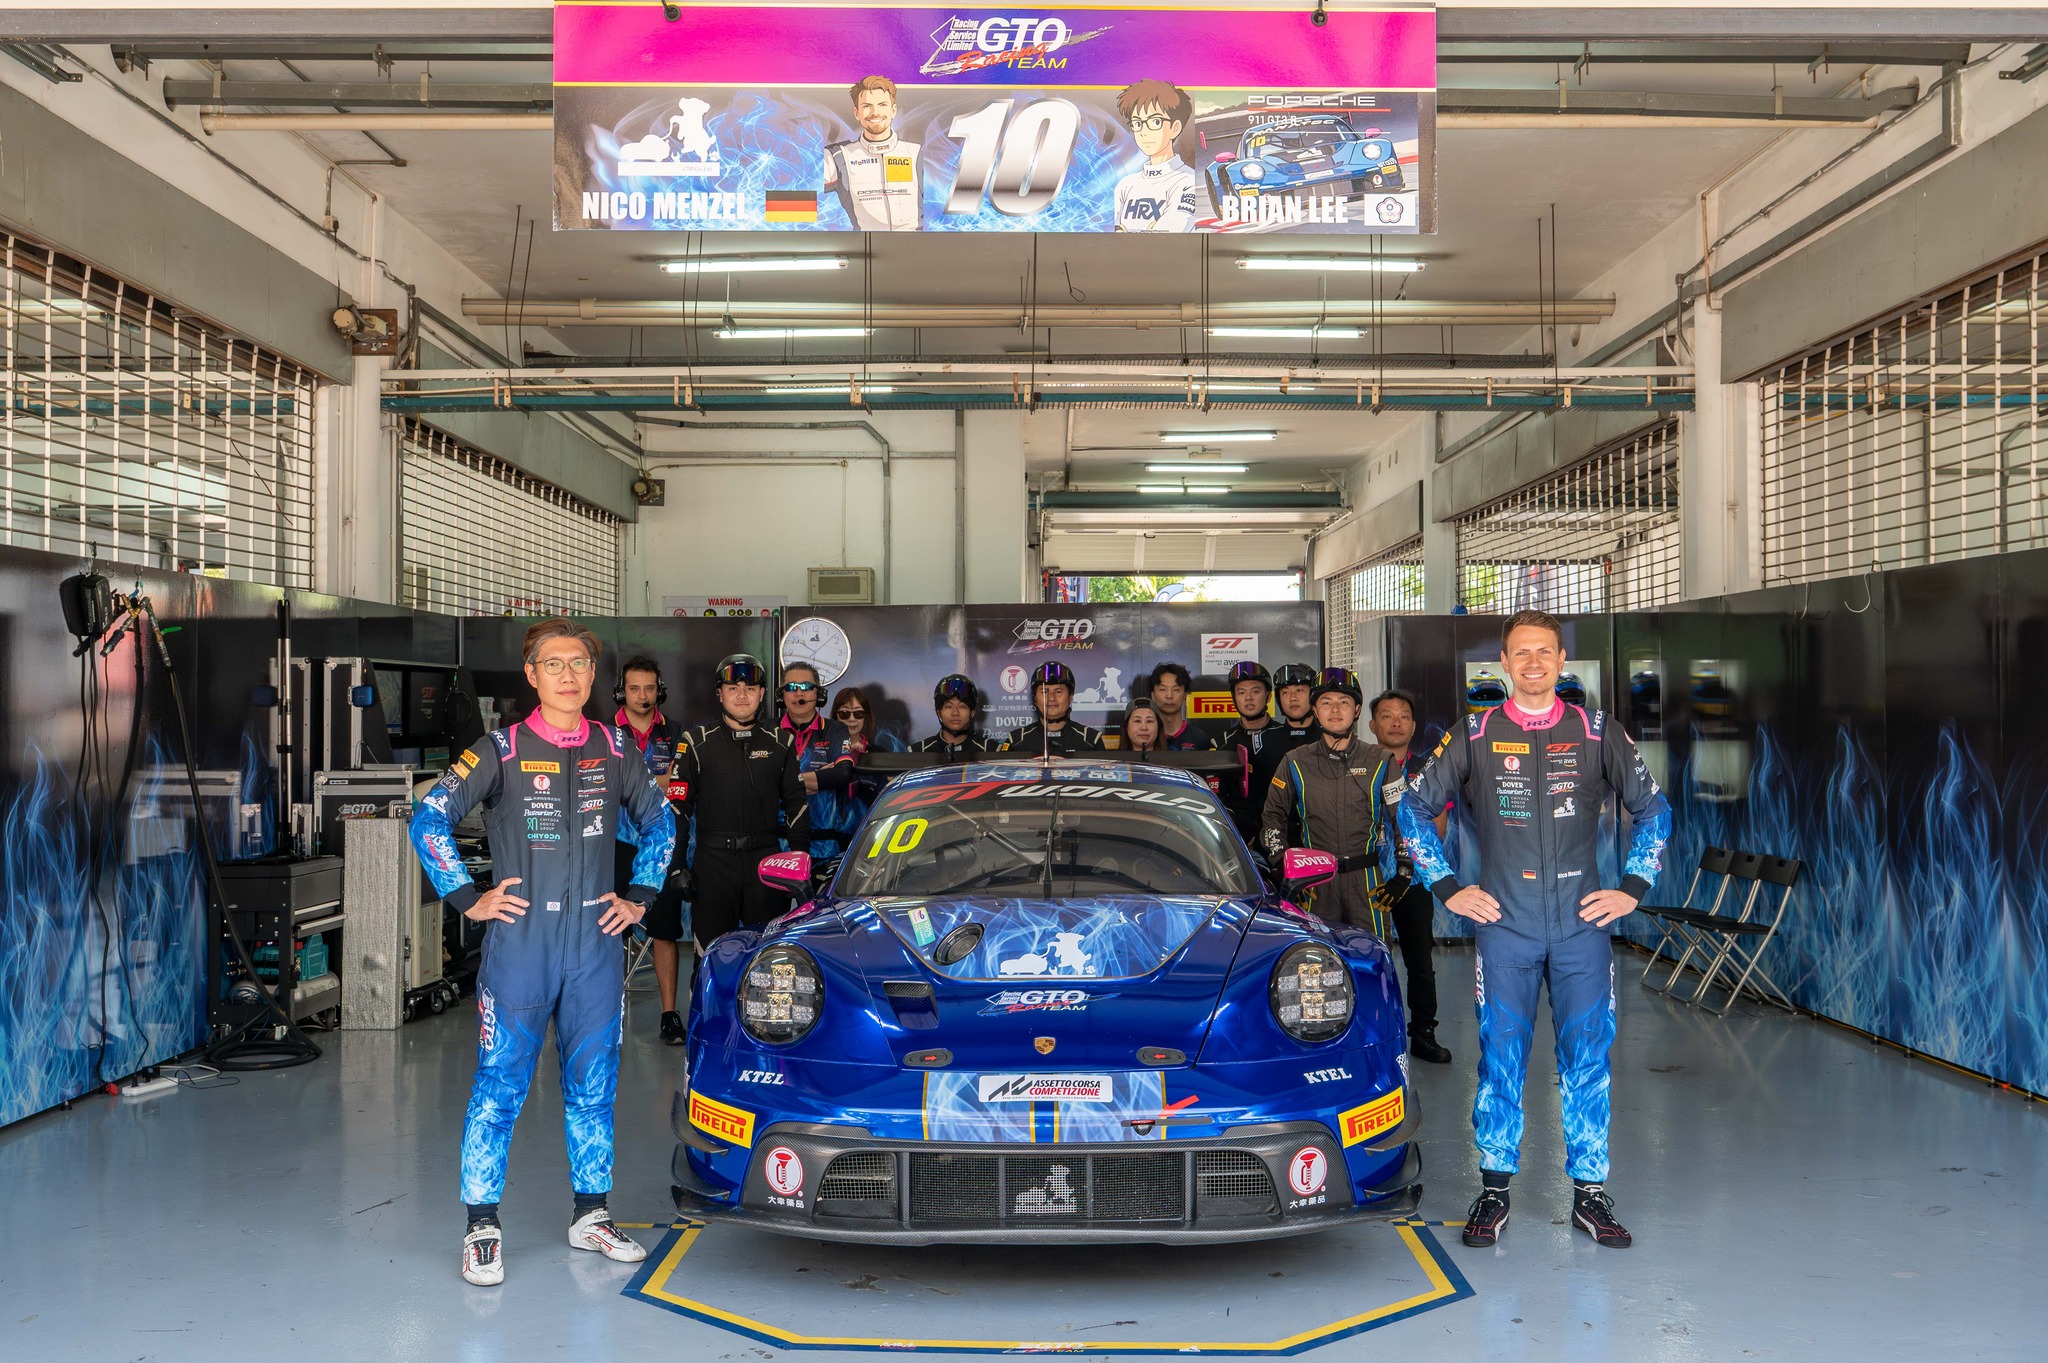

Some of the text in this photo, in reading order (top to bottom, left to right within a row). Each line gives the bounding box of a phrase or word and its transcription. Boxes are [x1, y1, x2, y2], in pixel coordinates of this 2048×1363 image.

[953, 19, 979, 29] Racing
[949, 31, 977, 40] Service
[977, 17, 1067, 53] GTO
[946, 41, 974, 50] Limited
[957, 42, 1049, 73] Racing
[1007, 57, 1068, 69] TEAM
[1248, 95, 1376, 106] PORSCHE
[1248, 115, 1265, 125] 911
[946, 97, 1082, 215] 10
[582, 191, 746, 220] NICO MENZEL
[1124, 198, 1166, 221] HRX
[1222, 195, 1302, 223] BRIAN
[1309, 195, 1349, 223] LEE
[708, 598, 743, 606] WARNING
[1040, 619, 1093, 640] GTO
[1058, 642, 1094, 650] TEAM
[1207, 637, 1254, 649] GT
[1194, 696, 1238, 714] PIRE
[1468, 713, 1478, 729] RX
[1496, 744, 1527, 752] PIRELLI
[524, 762, 557, 771] PIRELLI
[1556, 781, 1574, 790] GTO
[586, 799, 604, 808] GTO
[884, 779, 1217, 815] GT WORLD
[351, 803, 376, 815] GTO
[867, 818, 930, 859] 10
[764, 858, 799, 871] DOVER
[1293, 855, 1332, 868] DOVER
[1020, 990, 1086, 1005] GTO
[738, 1069, 785, 1085] KTEL
[1304, 1067, 1352, 1084] KTEL
[1033, 1079, 1101, 1088] ASSETTO CORSA
[1029, 1087, 1100, 1096] COMPETIZIONE
[692, 1096, 747, 1140] PIRELLI
[1347, 1095, 1402, 1139] PIRELLI
